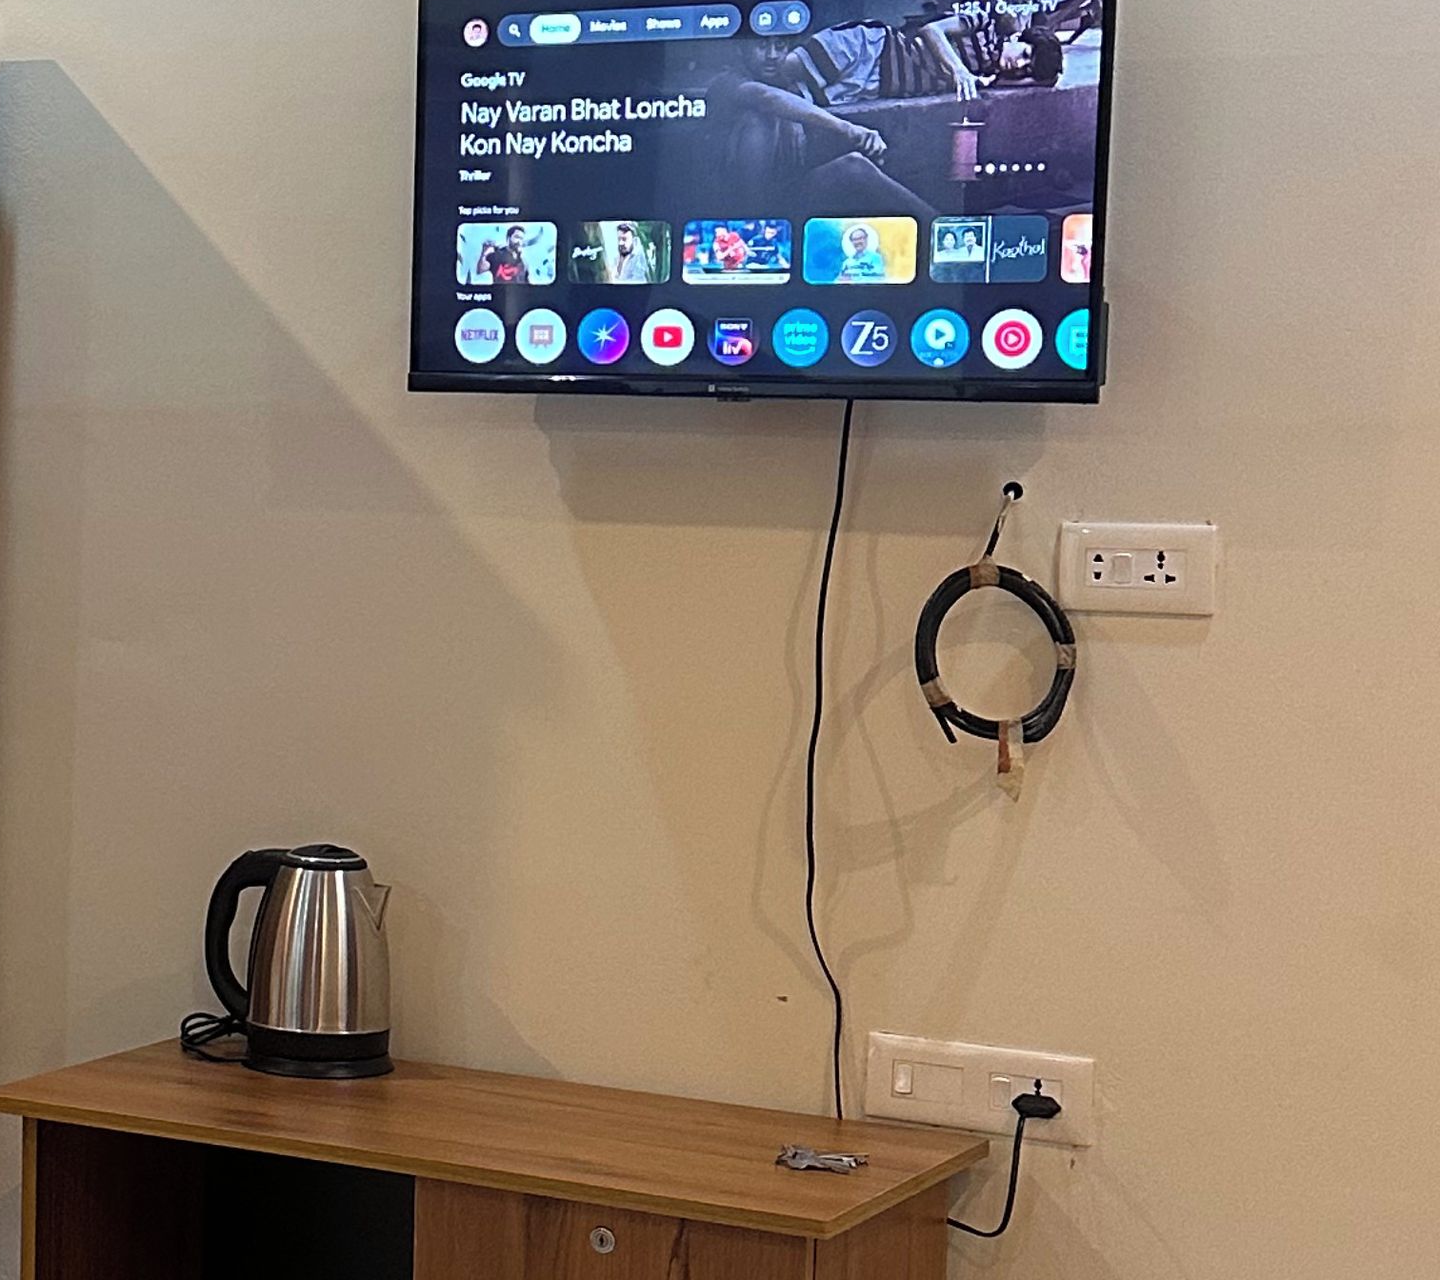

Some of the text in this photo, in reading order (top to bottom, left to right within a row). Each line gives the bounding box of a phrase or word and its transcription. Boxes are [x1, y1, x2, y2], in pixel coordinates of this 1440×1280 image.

[1041, 0, 1058, 12] TV
[542, 14, 730, 35] Home Movies Shows Apps
[461, 71, 526, 91] Google TV
[461, 94, 707, 129] Nay Varan Bhat Loncha
[460, 130, 633, 159] Kon Nay Koncha
[459, 170, 492, 182] Thriller
[504, 207, 520, 216] you
[473, 292, 492, 302] apps
[719, 322, 748, 332] SONY
[783, 321, 818, 336] prime
[460, 328, 499, 341] NETFLIX
[784, 333, 817, 346] video
[849, 321, 889, 356] Z5
